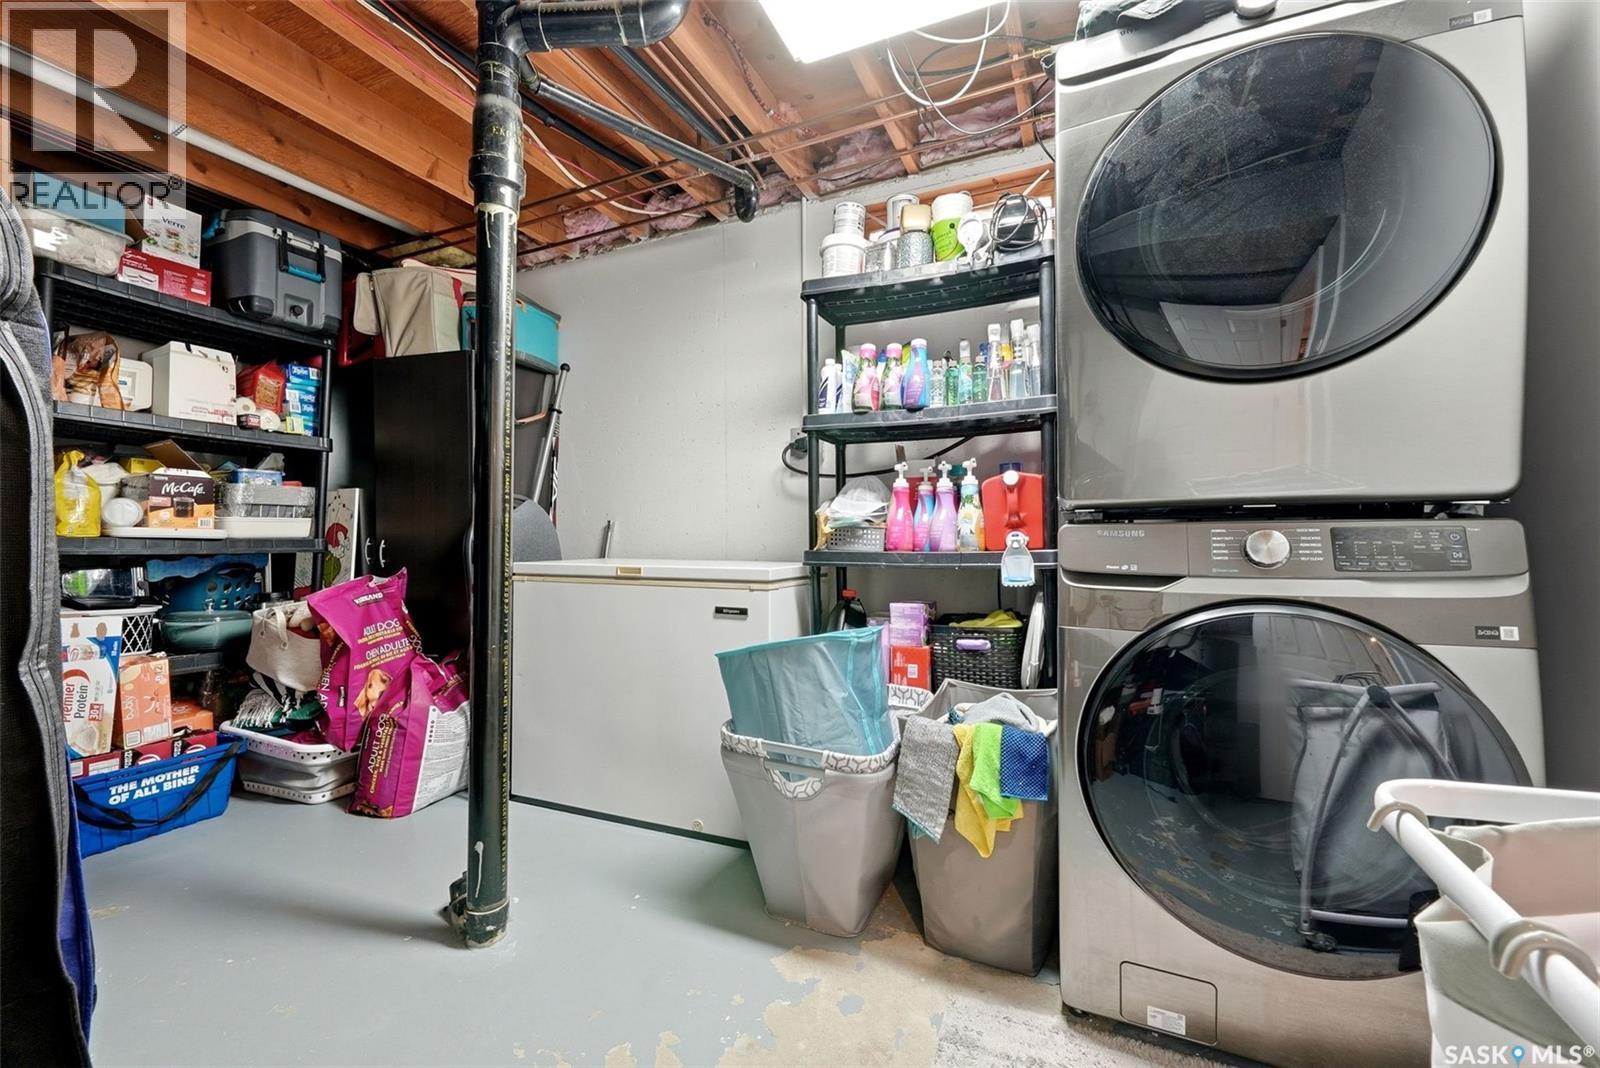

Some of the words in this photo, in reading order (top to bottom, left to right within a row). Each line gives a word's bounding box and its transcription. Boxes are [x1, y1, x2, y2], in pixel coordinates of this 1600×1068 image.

[162, 216, 186, 229] Verre
[1097, 529, 1145, 537] SAMSUNG
[377, 617, 400, 631] DOG
[63, 683, 75, 722] Premier
[74, 684, 88, 719] Protein
[368, 739, 380, 773] ADULT
[108, 780, 137, 795] THE
[141, 765, 199, 788] MOTHER
[108, 792, 130, 805] OF
[133, 785, 160, 799] ALL
[163, 775, 196, 791] BINS
